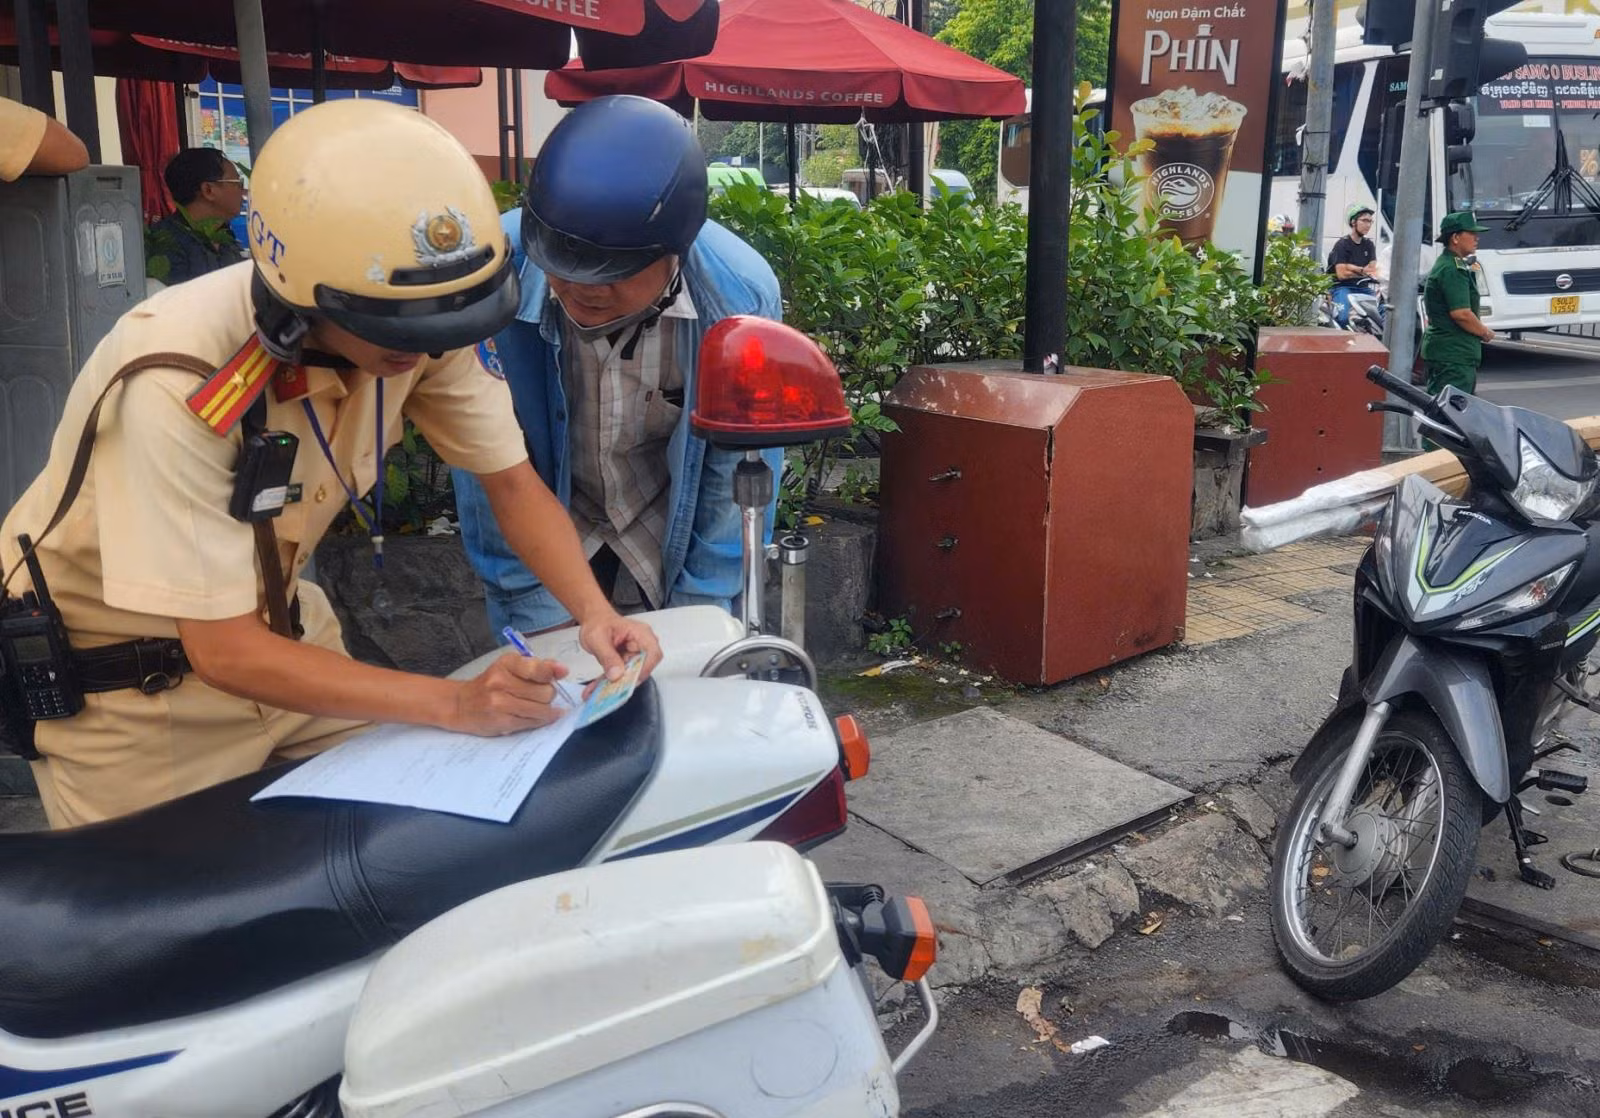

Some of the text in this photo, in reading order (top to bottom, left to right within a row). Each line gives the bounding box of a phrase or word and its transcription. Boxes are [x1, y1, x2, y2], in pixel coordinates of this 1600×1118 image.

[516, 0, 600, 20] FEE
[1146, 2, 1246, 22] Ngon Đậm Chất
[704, 81, 883, 103] HIGHLANDS COFFEE
[1389, 81, 1409, 92] SAM
[1151, 166, 1211, 189] HIGHLANDS
[1161, 203, 1202, 219] OFFEE
[1458, 510, 1492, 525] HONDA
